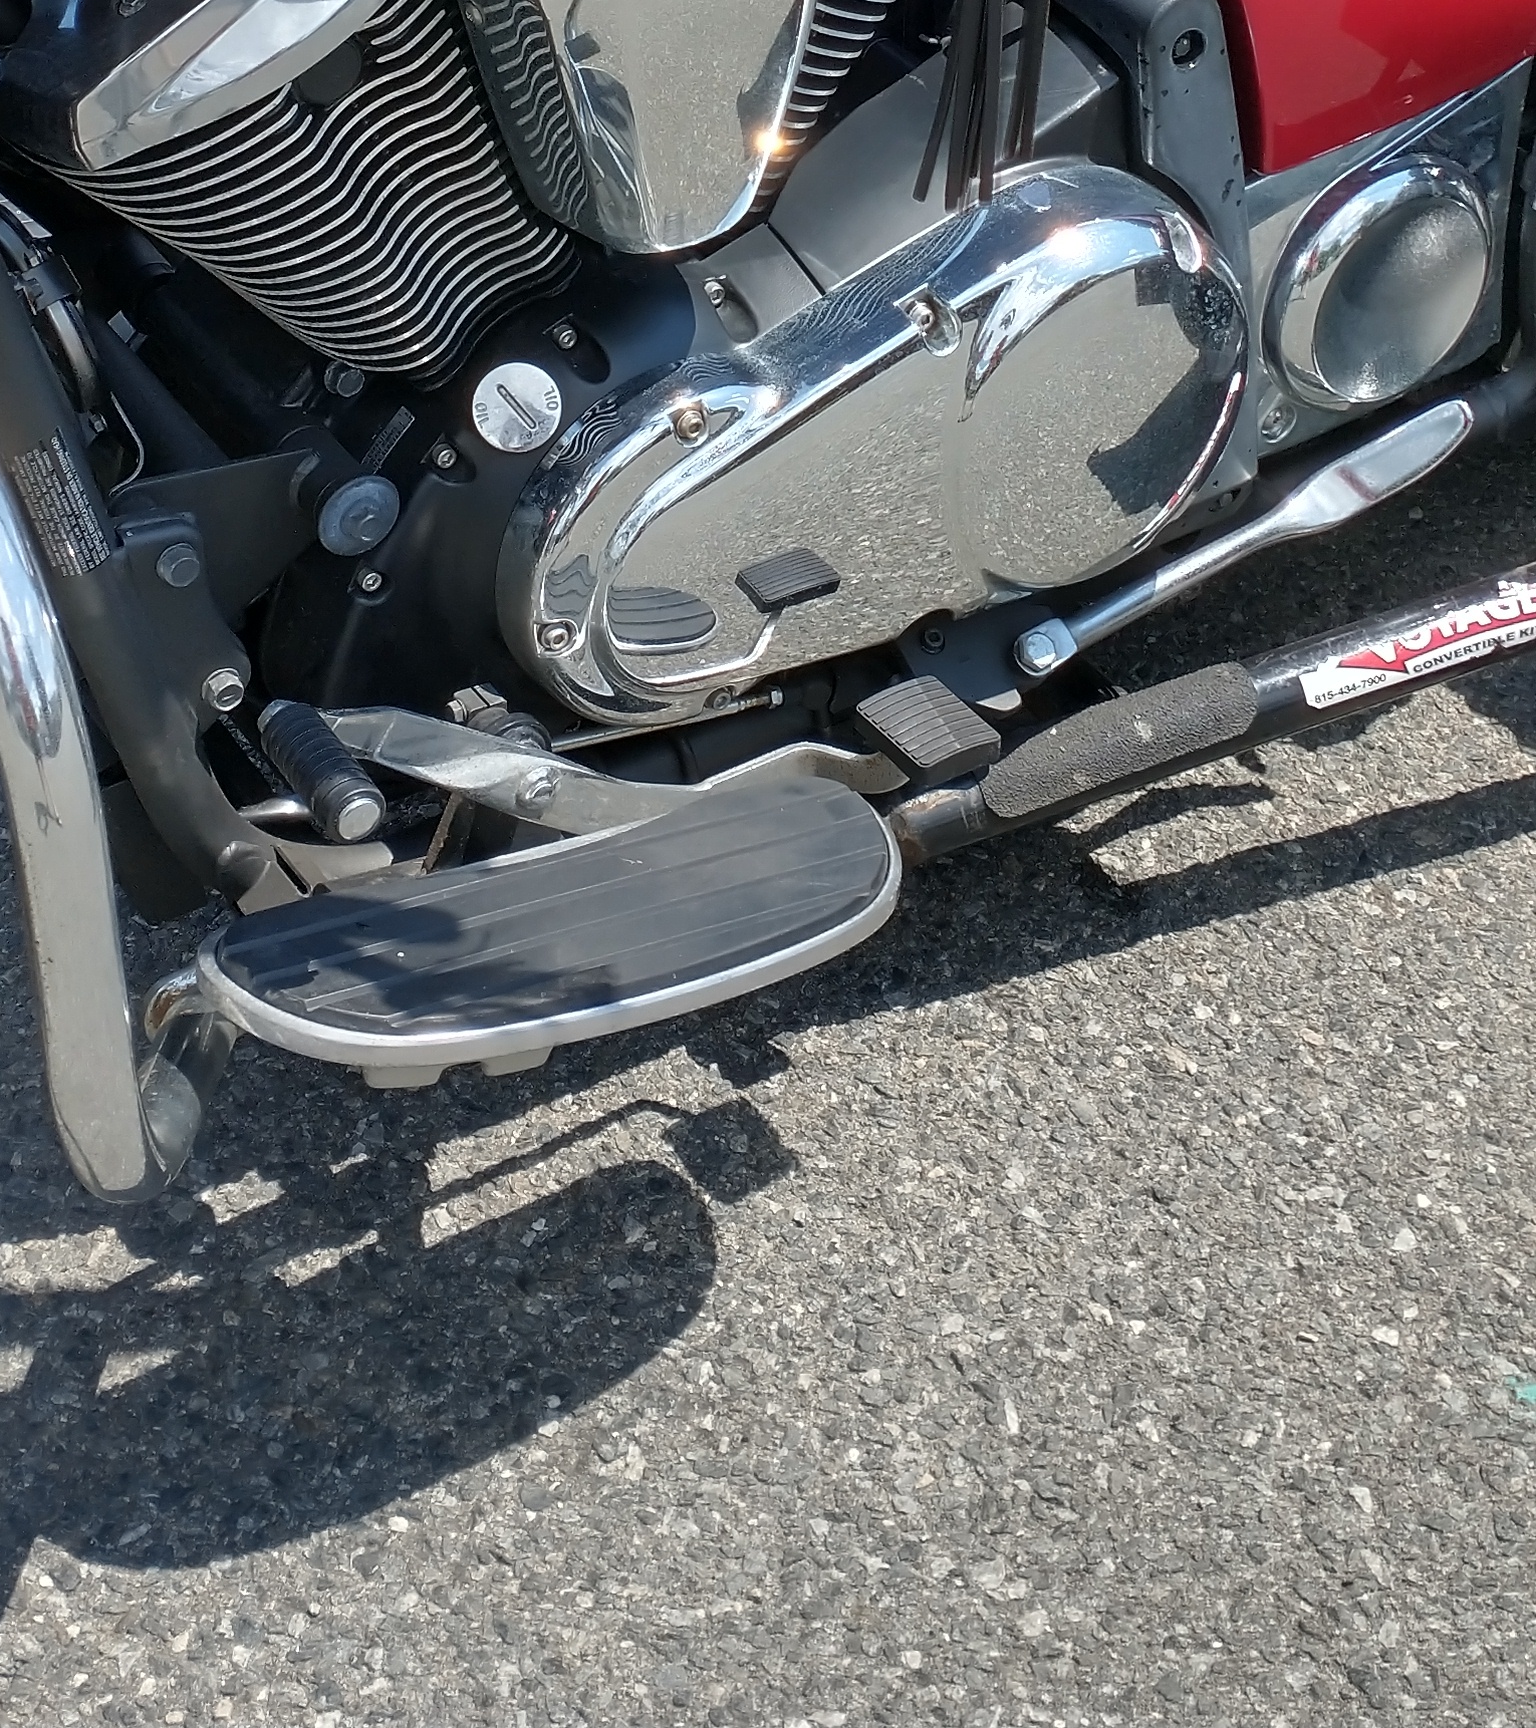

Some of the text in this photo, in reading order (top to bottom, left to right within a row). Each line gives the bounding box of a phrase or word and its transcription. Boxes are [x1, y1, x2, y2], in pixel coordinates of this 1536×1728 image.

[544, 385, 560, 412] OIL
[474, 402, 490, 430] OIL
[1413, 632, 1516, 673] CONVERTIBLE
[1314, 673, 1387, 704] 815-434-7900
